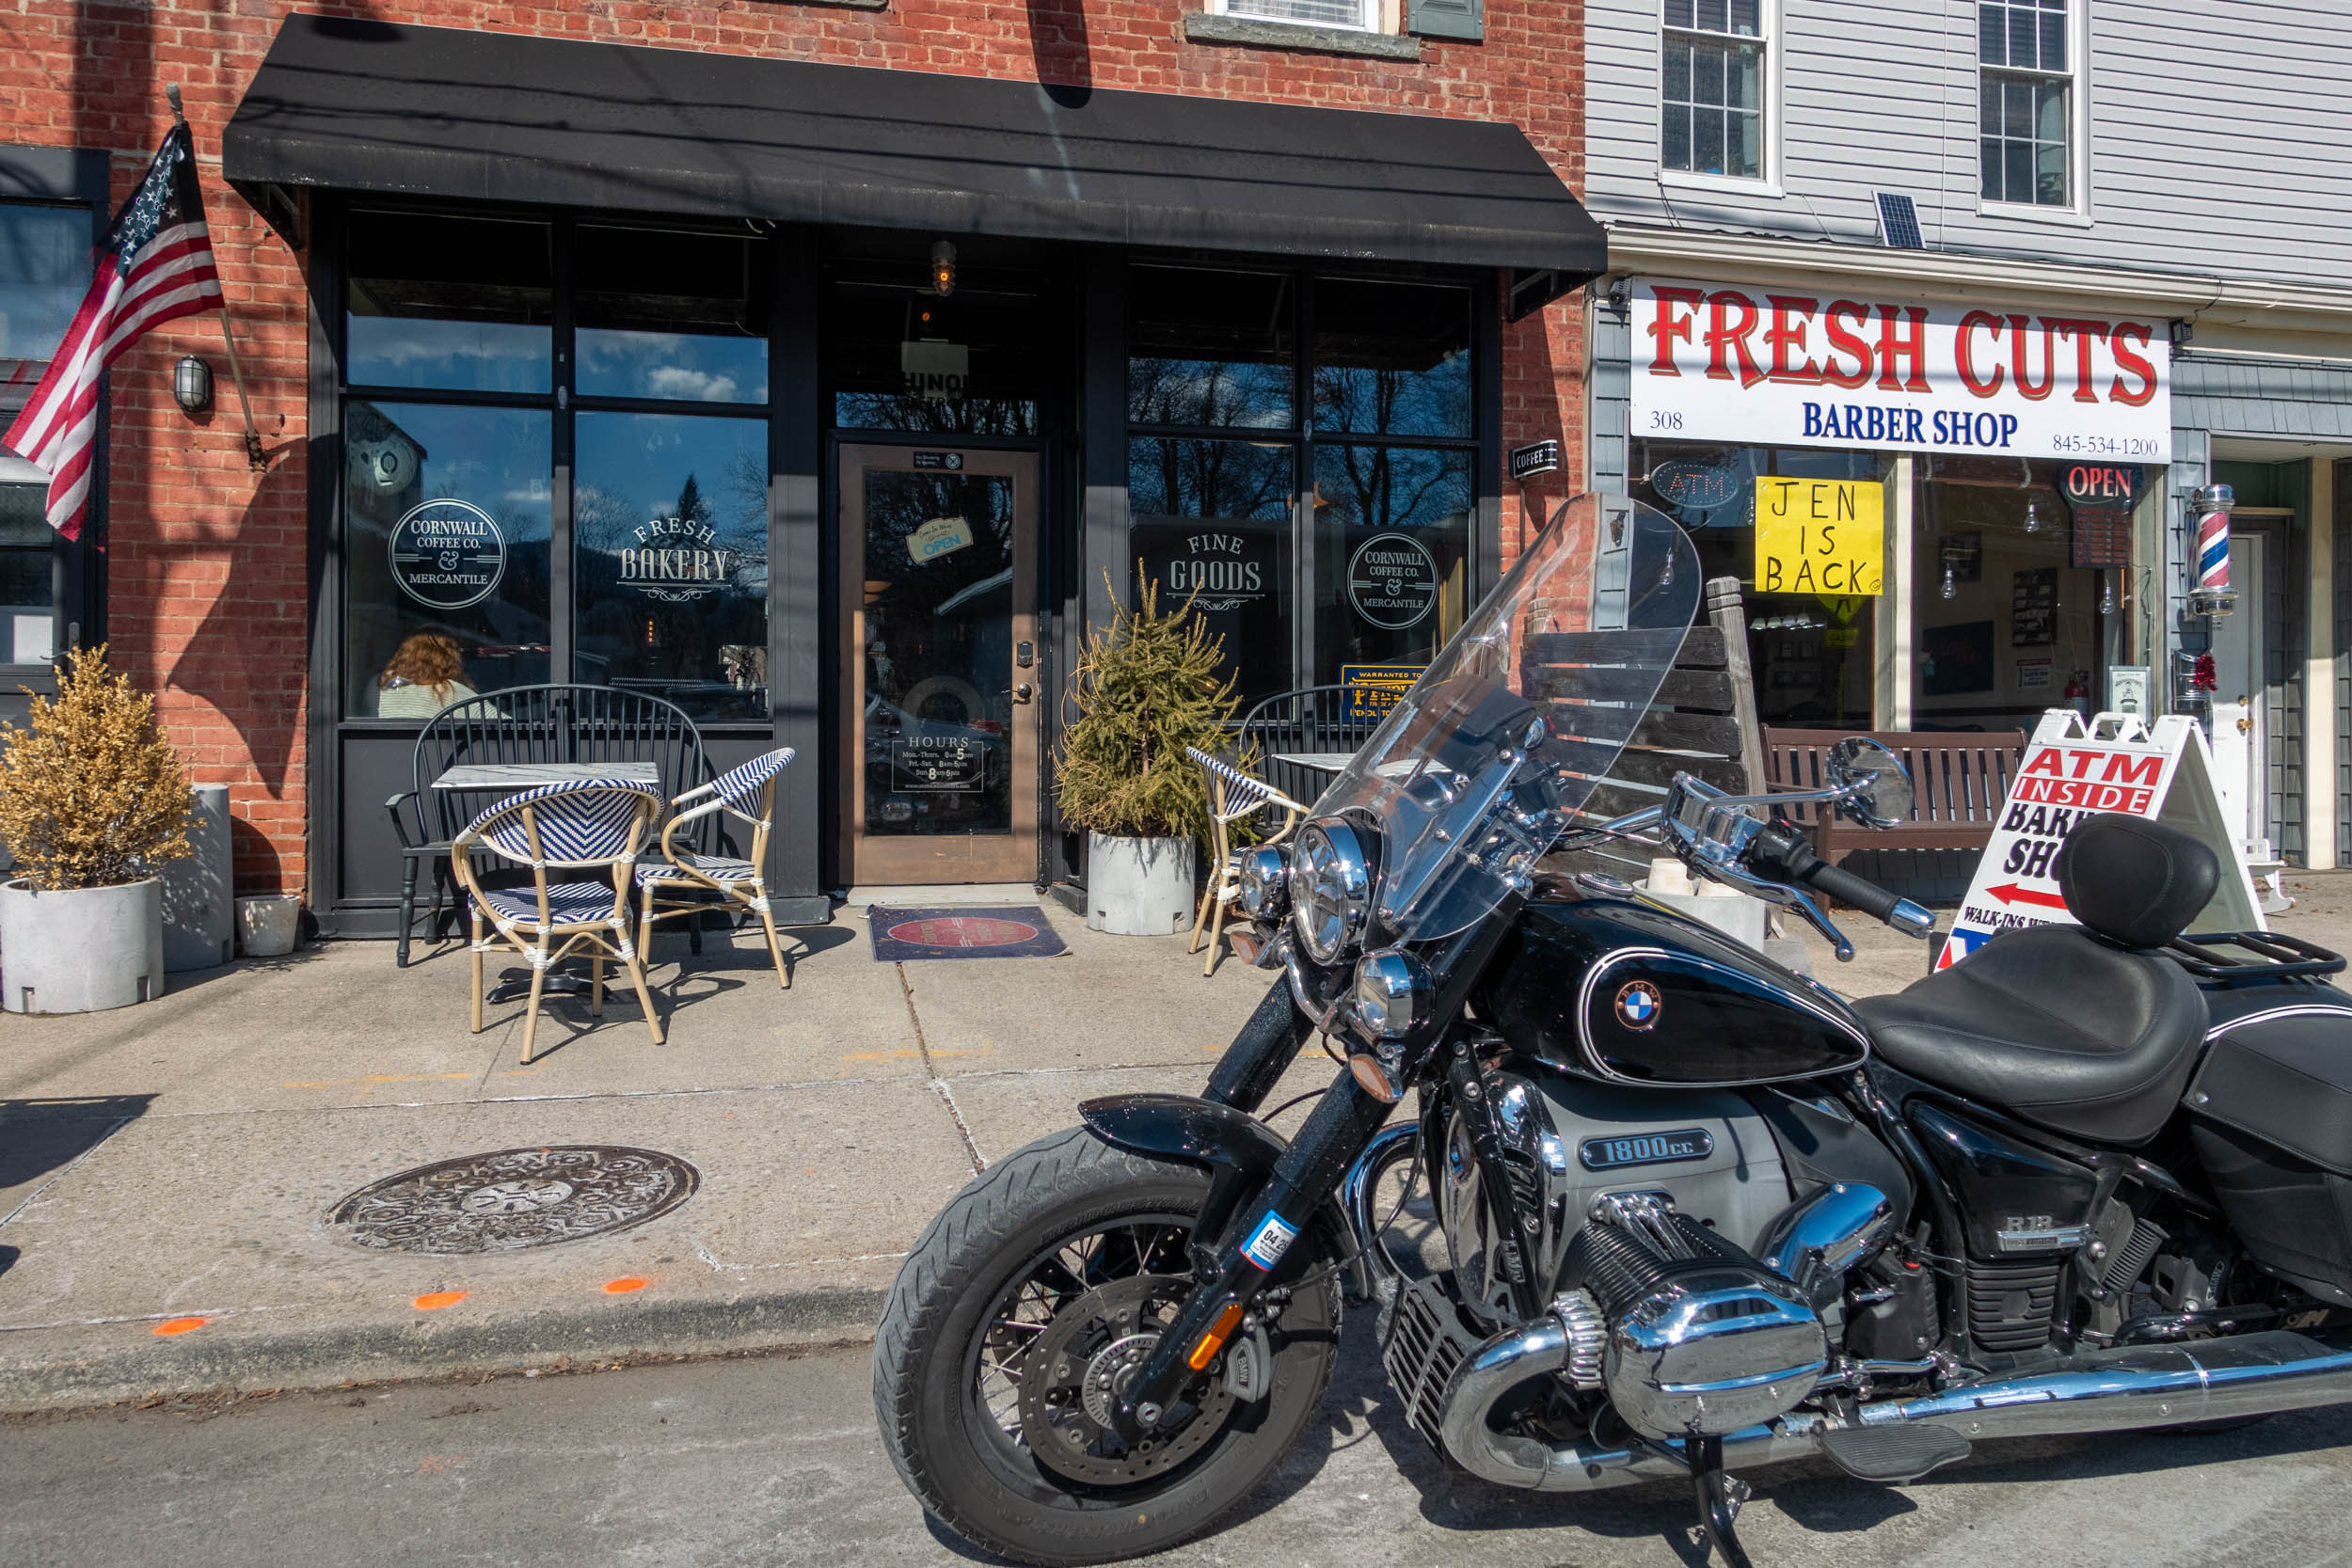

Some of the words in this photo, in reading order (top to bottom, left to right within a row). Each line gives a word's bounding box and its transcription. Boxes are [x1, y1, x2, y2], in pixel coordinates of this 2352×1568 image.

[1646, 285, 1932, 392] FRESH
[1954, 309, 2157, 406] CUTS
[1649, 410, 1682, 430] 308
[1802, 402, 1926, 444] BARBER
[1932, 410, 2018, 448] SHOP
[2053, 435, 2158, 455] 845-534-1200
[1517, 449, 1543, 468] COFFEE
[1668, 472, 1724, 497] ATM
[2069, 466, 2132, 498] OPEN
[1772, 481, 1855, 521] JEN
[410, 519, 488, 536] CORNWALL
[633, 517, 716, 546] FRESH
[417, 536, 461, 548] COFFEE
[463, 538, 482, 549] CO.
[923, 533, 961, 556] OPEN
[1186, 533, 1244, 555] FINE
[1801, 525, 1836, 555] IS
[438, 550, 459, 571] &
[620, 547, 730, 580] BAKERY
[1364, 551, 1424, 566] CORNWALL
[409, 573, 488, 585] MERCANTILE
[1170, 560, 1261, 591] GOODS
[1369, 566, 1404, 577] COFFEE
[1405, 567, 1420, 578] CO.
[1767, 556, 1867, 594] BACK
[1385, 578, 1402, 595] &
[1363, 597, 1424, 609] MERCANTILE
[909, 736, 969, 748] HOURS
[2023, 748, 2164, 786] ATM
[2015, 778, 2151, 814] INSIDE
[1963, 906, 2026, 928] WALK-INS
[1621, 984, 1657, 998] BMW
[1263, 1229, 1279, 1244] 04
[1237, 1355, 1249, 1387] BMW
